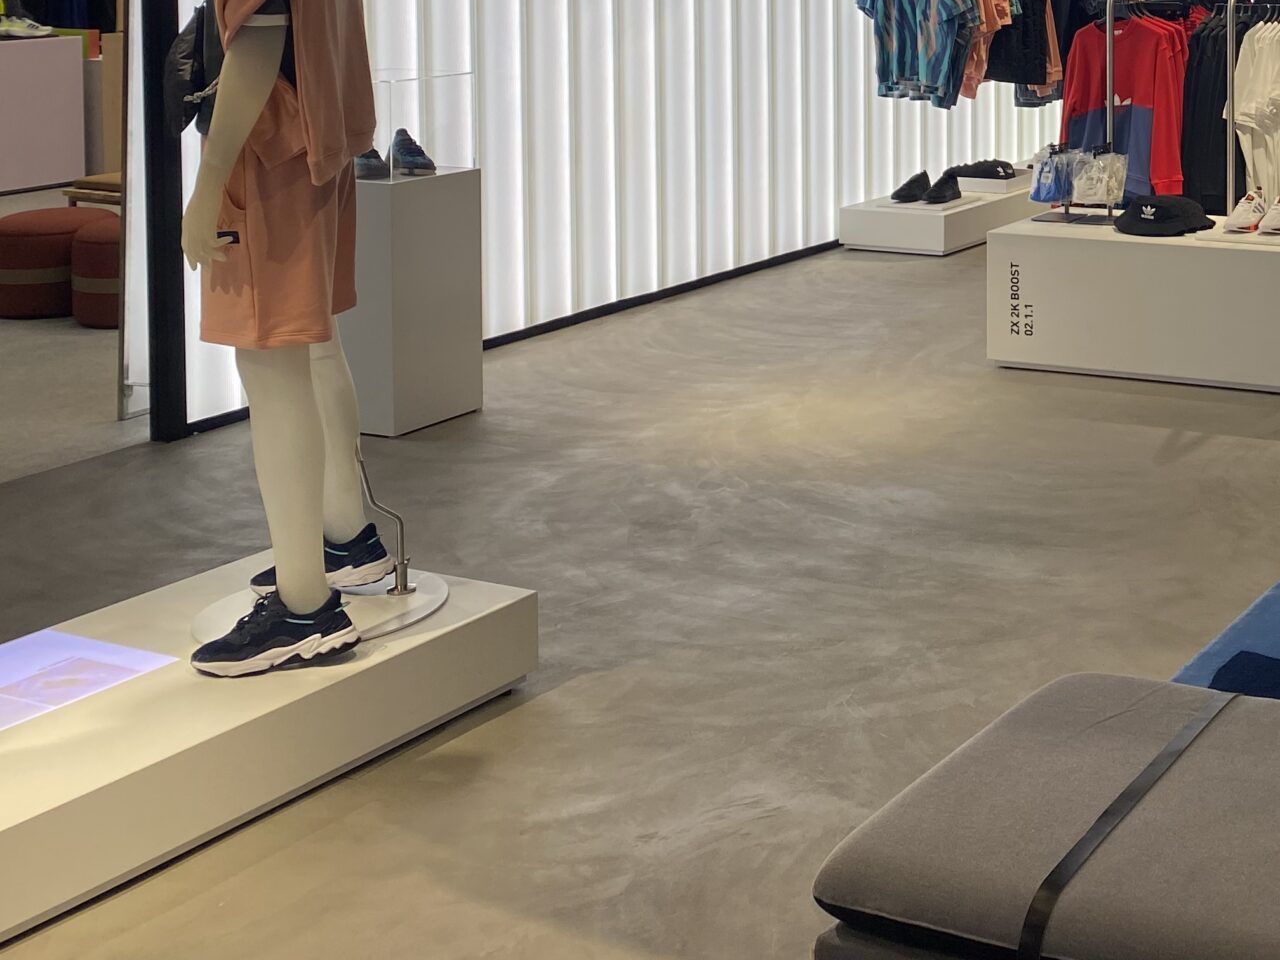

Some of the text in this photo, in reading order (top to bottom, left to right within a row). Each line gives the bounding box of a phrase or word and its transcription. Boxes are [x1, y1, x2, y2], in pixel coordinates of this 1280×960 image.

[1010, 261, 1020, 336] ZX 2K BOOST
[1024, 304, 1034, 336] 02.1.1
